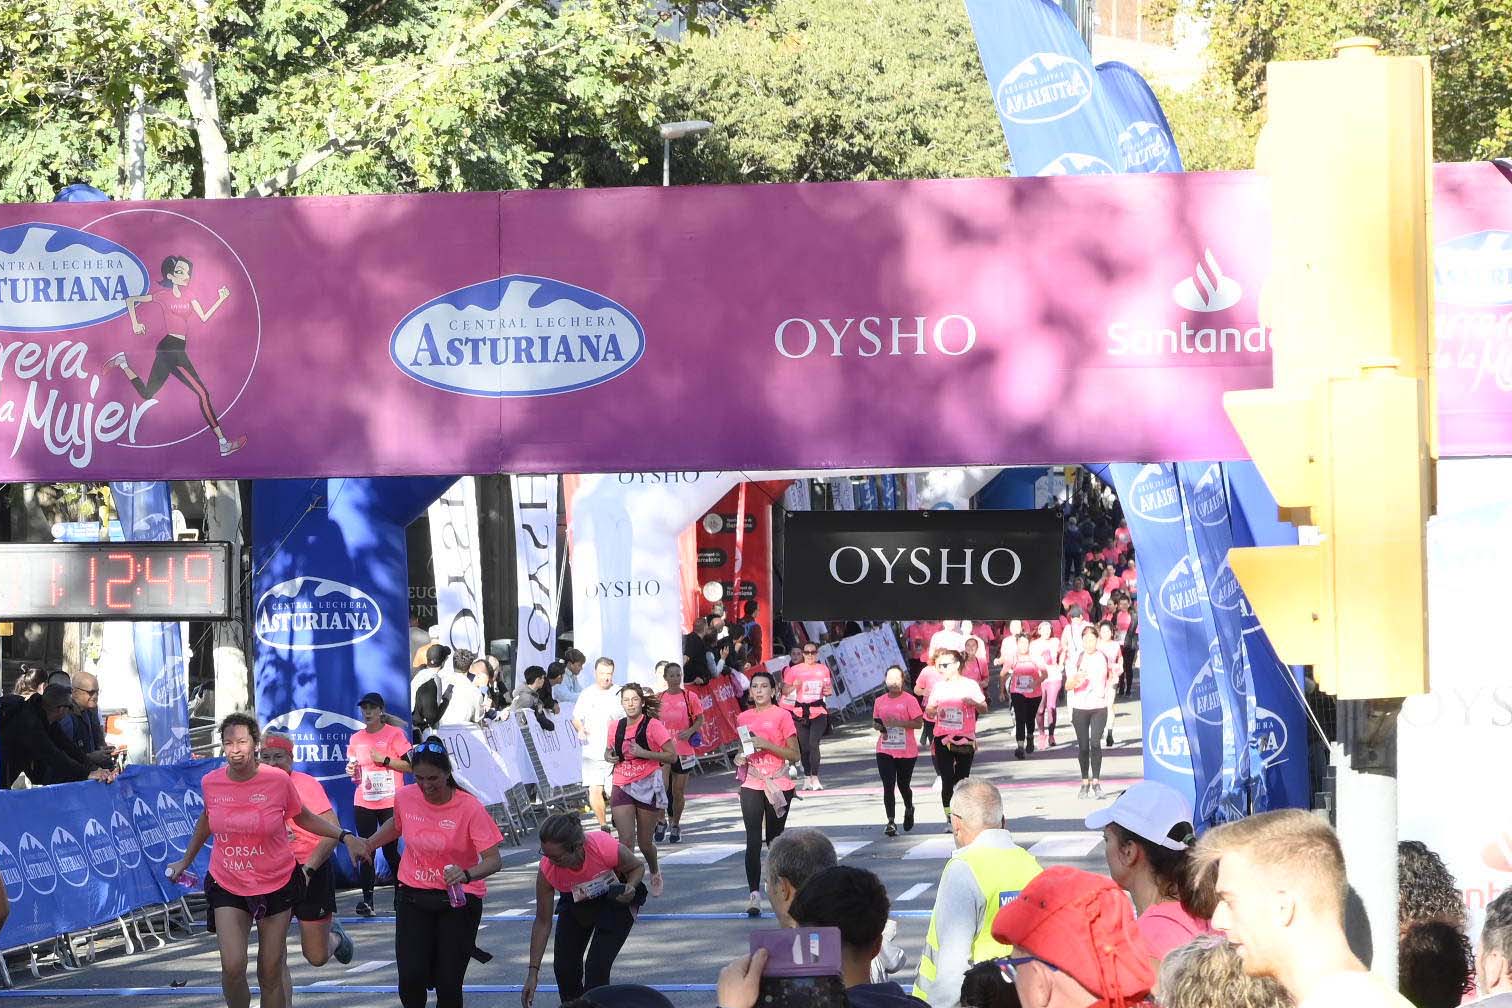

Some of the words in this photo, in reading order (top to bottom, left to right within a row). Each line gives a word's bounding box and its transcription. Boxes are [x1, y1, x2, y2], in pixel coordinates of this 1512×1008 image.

[52, 258, 124, 271] LECHERA
[449, 316, 528, 331] CENTRAL
[536, 314, 617, 328] LECHERA
[409, 321, 625, 367] ASTURIANA
[774, 314, 977, 359] OYSHO
[10, 374, 159, 469] Mujer
[829, 546, 1023, 587] OYSHO
[585, 579, 661, 599] OYSHO
[271, 601, 315, 610] CENTRAL
[318, 600, 368, 609] LECHERA
[259, 607, 373, 634] ASTURIANA
